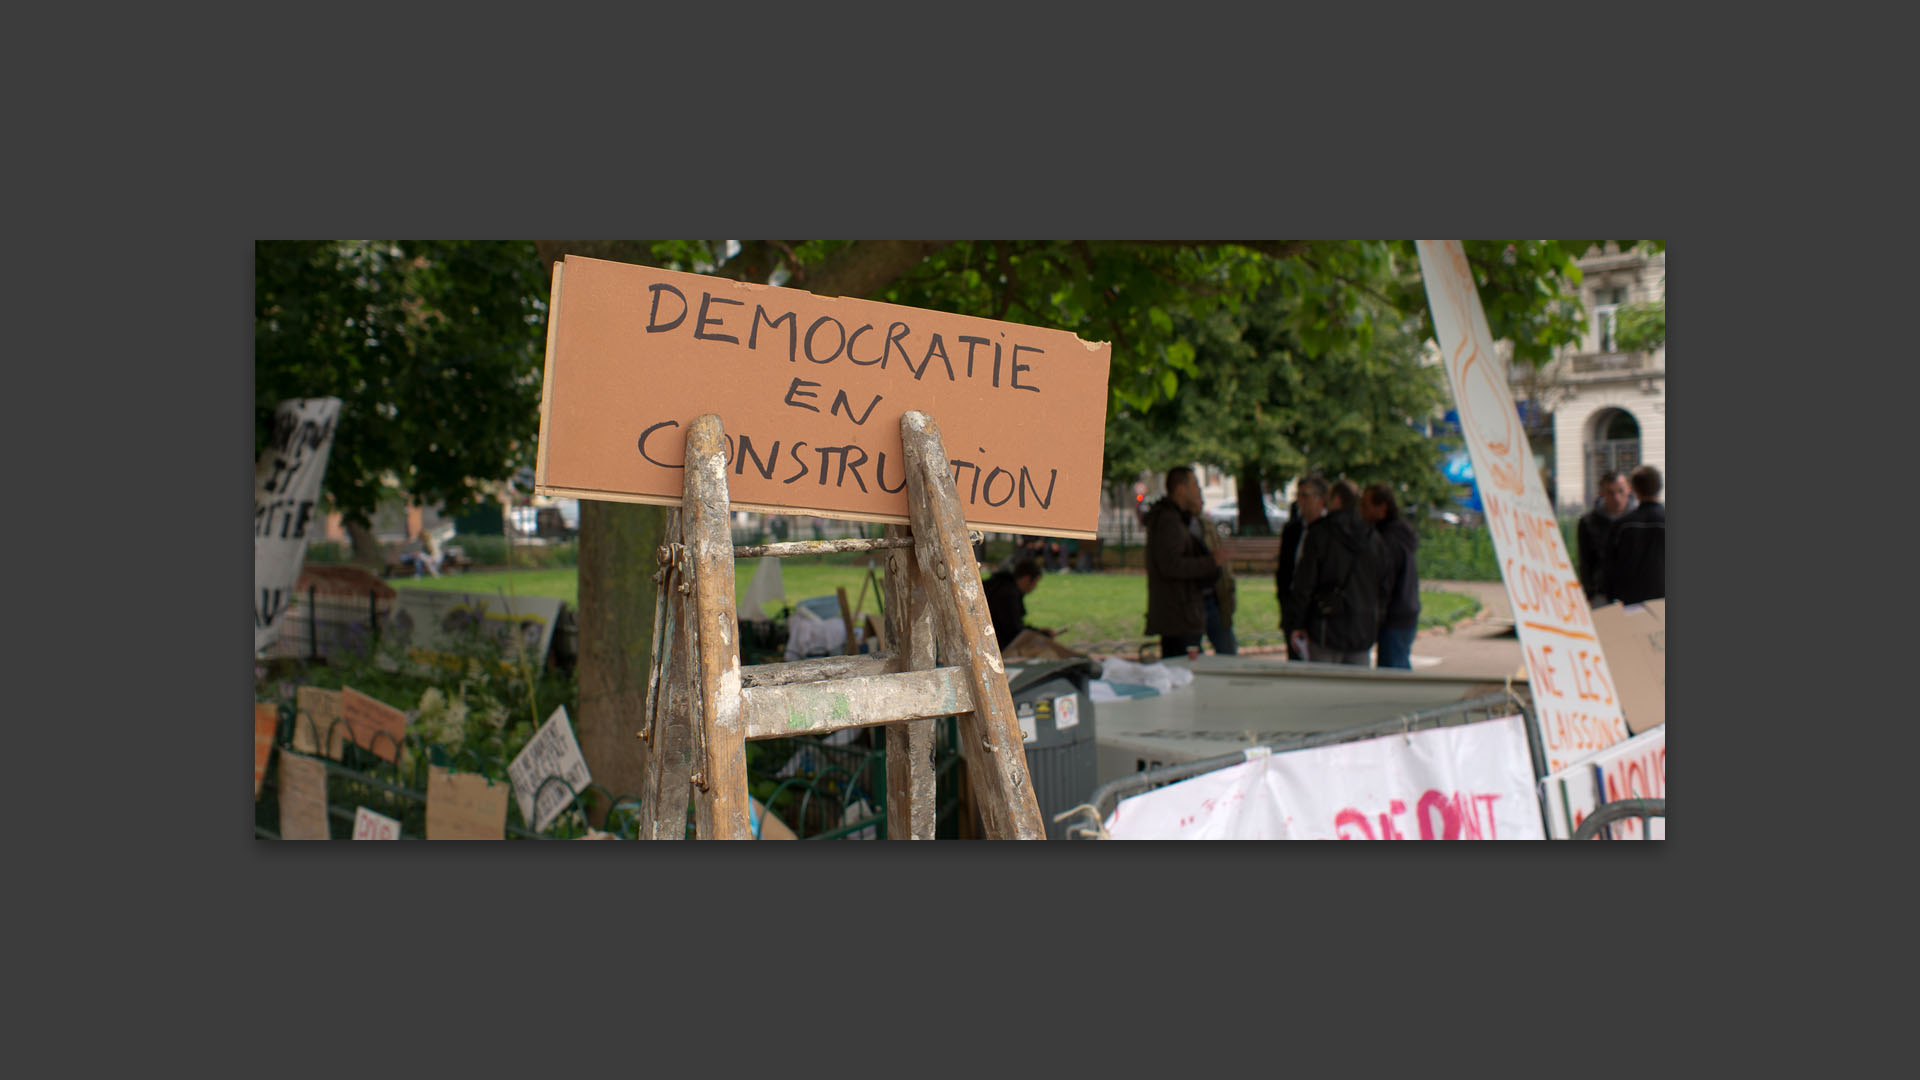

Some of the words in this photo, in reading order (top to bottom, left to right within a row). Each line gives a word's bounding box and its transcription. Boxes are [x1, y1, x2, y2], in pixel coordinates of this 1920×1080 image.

[784, 377, 883, 426] EN
[638, 419, 1058, 511] CNSTRUTION
[1526, 643, 1565, 698] NE
[1567, 647, 1614, 706] LES
